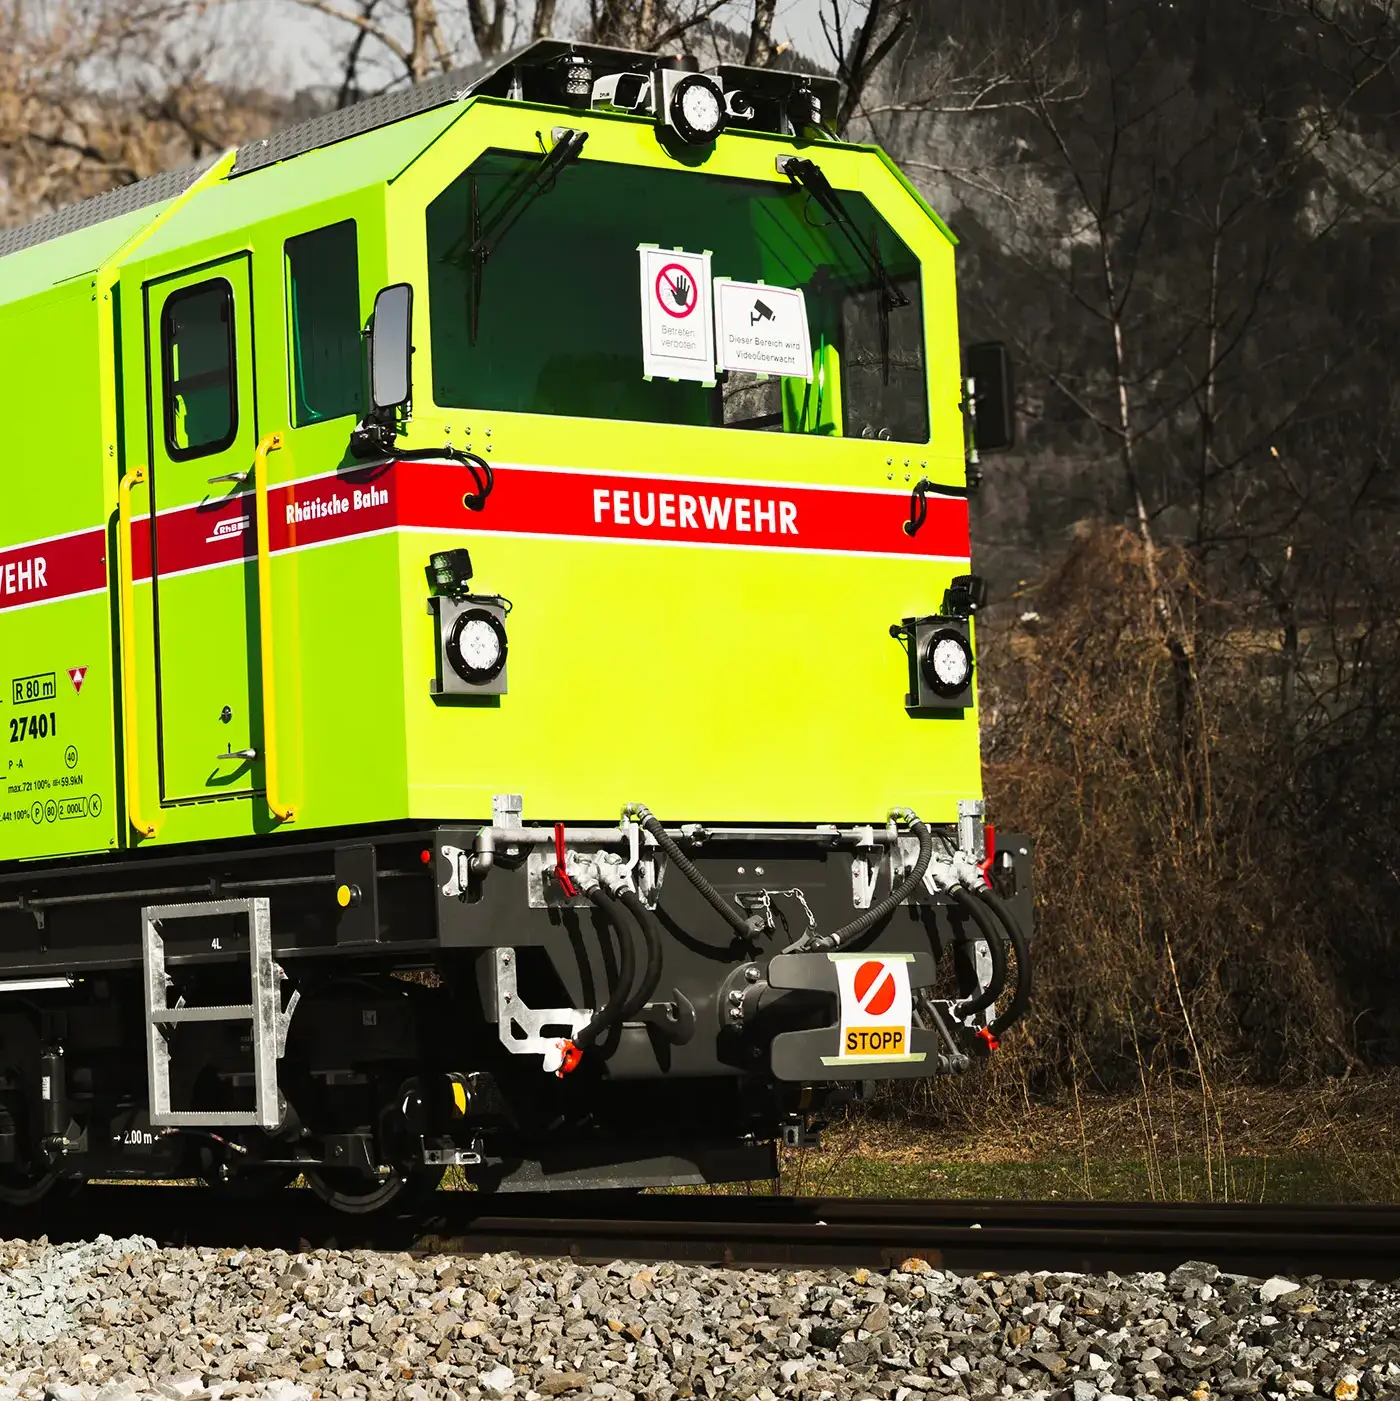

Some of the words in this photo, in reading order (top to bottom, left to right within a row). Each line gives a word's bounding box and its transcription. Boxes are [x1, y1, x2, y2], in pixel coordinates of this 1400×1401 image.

[661, 324, 695, 337] Betreten
[661, 338, 696, 350] verboten
[728, 334, 753, 345] Dieser
[754, 336, 783, 348] Bereich
[785, 341, 800, 350] wird
[286, 493, 350, 525] Rhätische
[353, 485, 389, 511] Bahn
[592, 488, 800, 535] FEUERWEHR
[15, 683, 23, 700] R
[26, 679, 40, 698] 80
[42, 681, 53, 696] m
[9, 712, 56, 743] 27401
[8, 760, 14, 770] P
[211, 937, 223, 950] 4L
[846, 1031, 903, 1050] STOPP
[123, 1129, 143, 1145] 2.00
[143, 1133, 153, 1145] m
